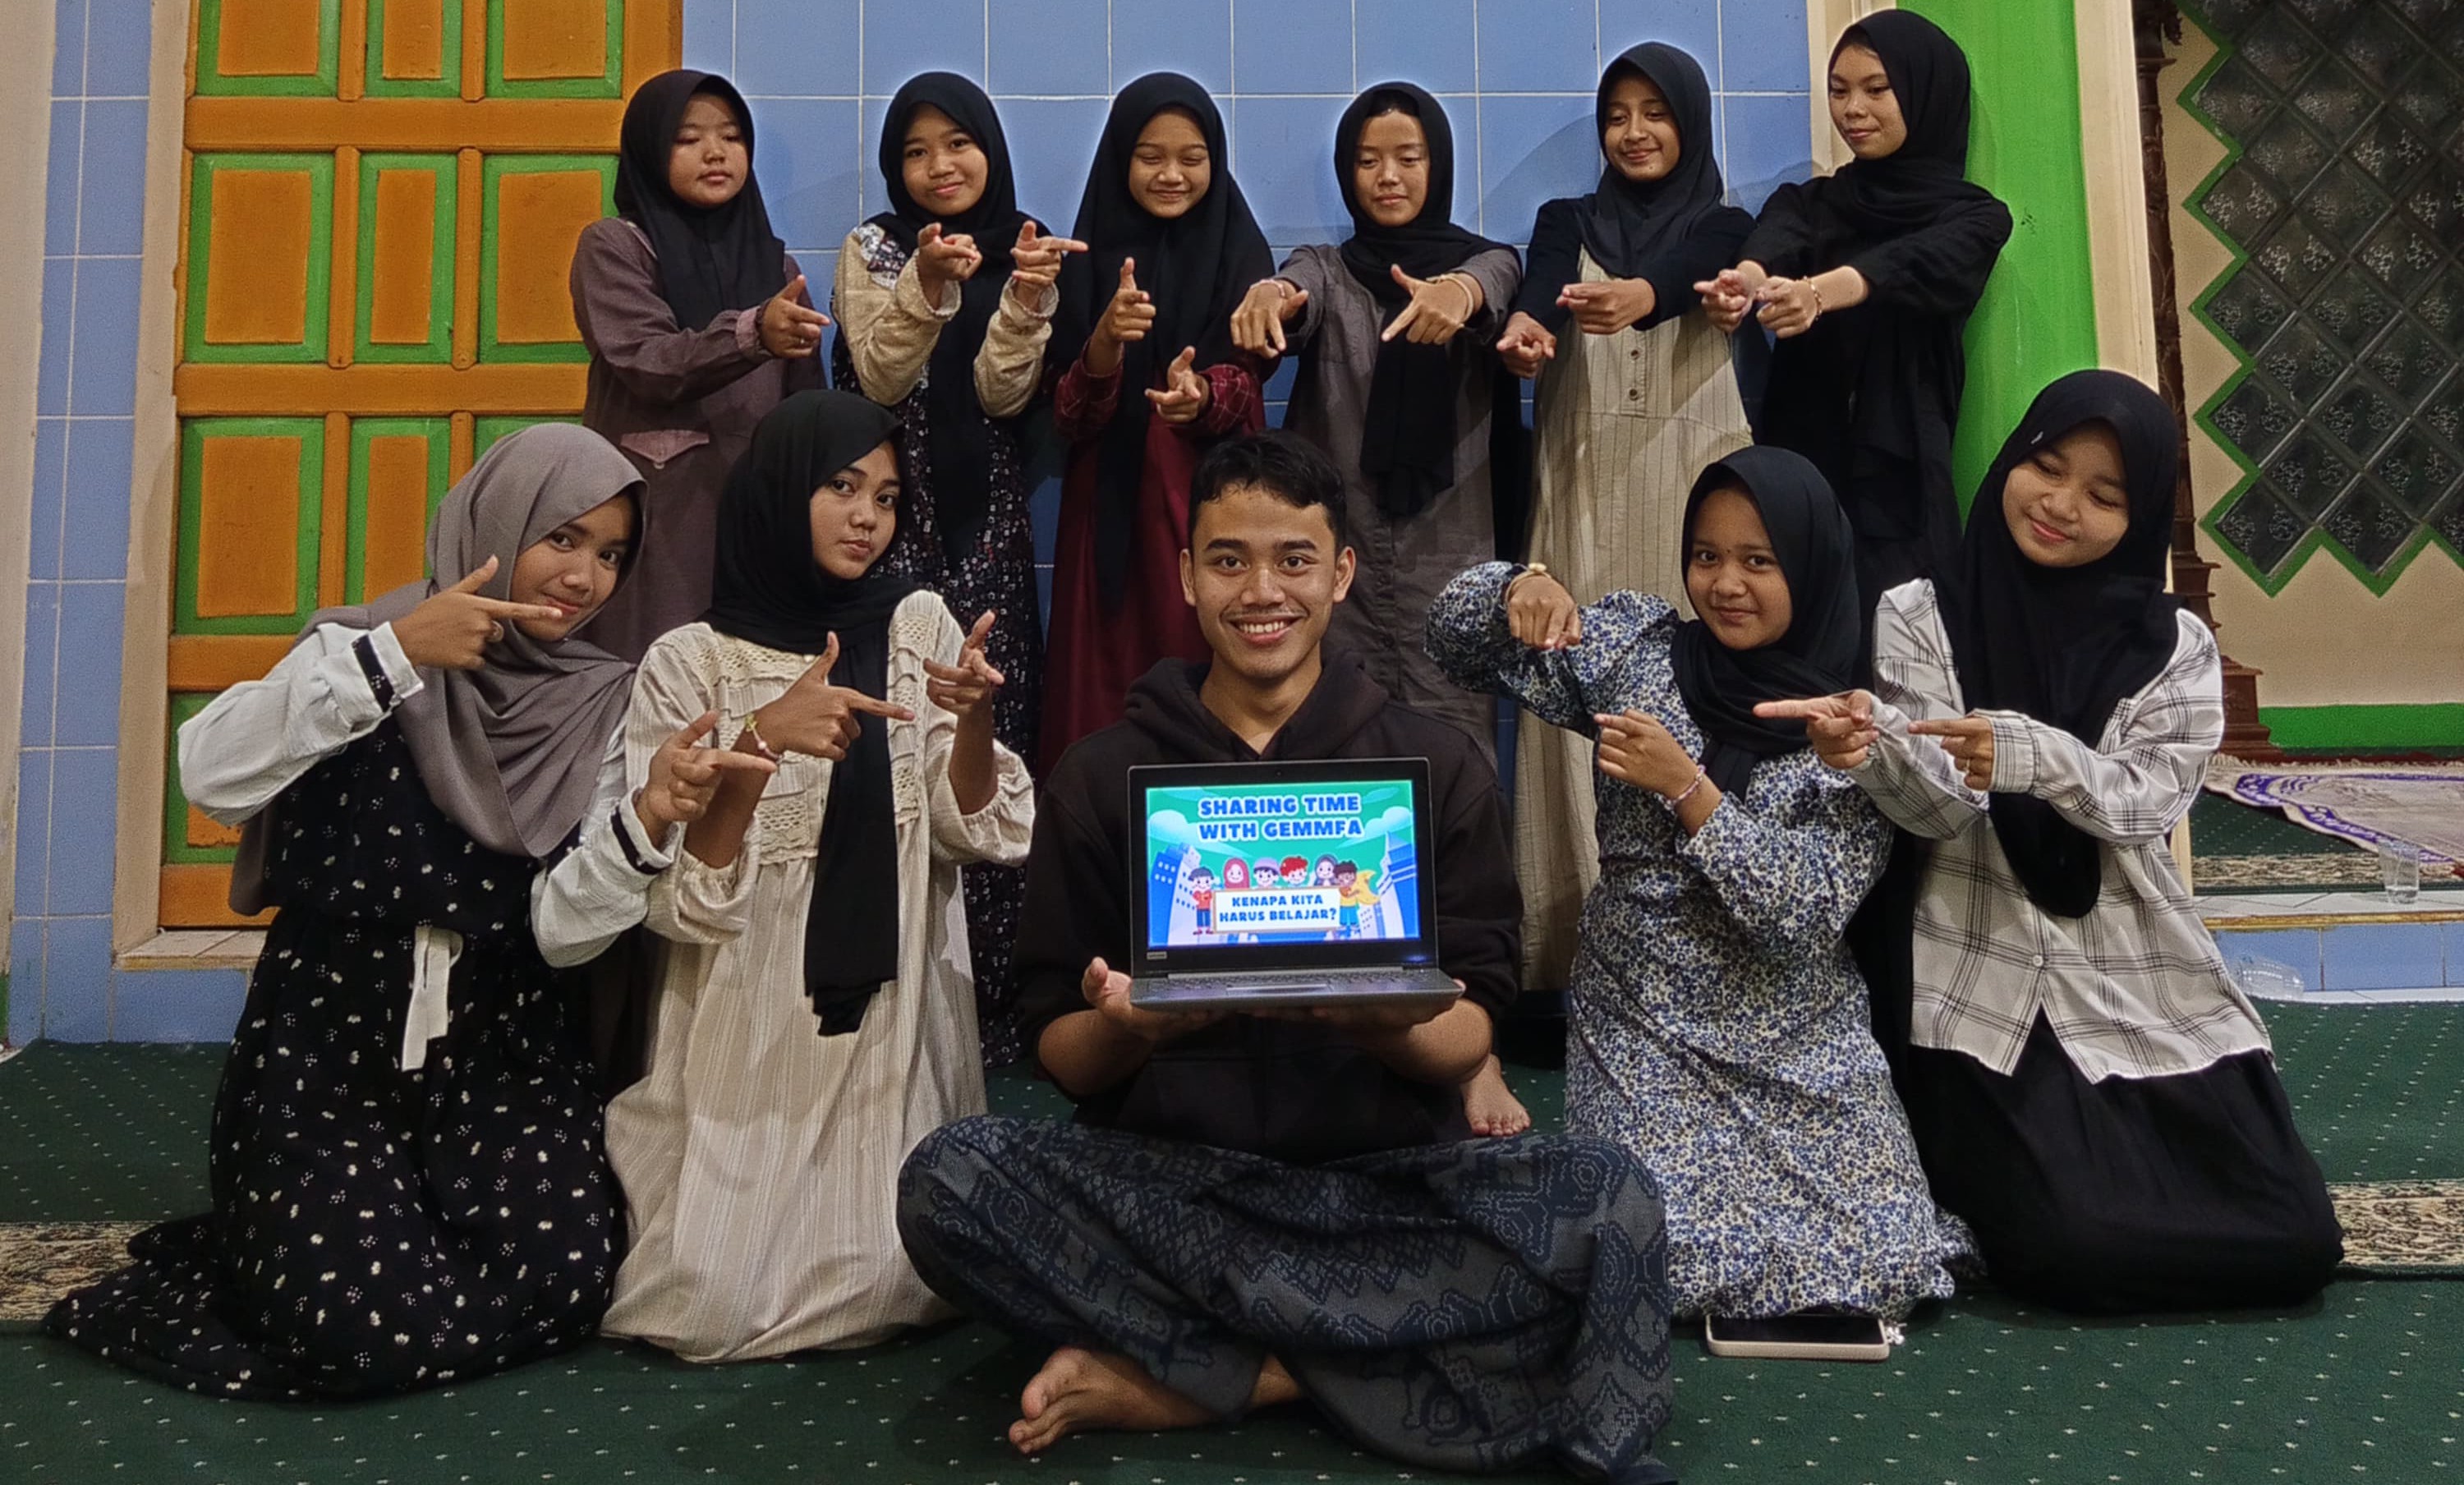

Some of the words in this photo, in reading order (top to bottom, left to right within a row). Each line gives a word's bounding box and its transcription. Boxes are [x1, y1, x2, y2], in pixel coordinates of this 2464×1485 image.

[1200, 798, 1297, 816] SHARING
[1304, 796, 1359, 811] TIME
[1199, 823, 1257, 839] WITH
[1264, 820, 1363, 838] GEMMFA
[1232, 895, 1287, 908] KENAPA
[1291, 894, 1323, 905] KITA
[1220, 910, 1266, 922] HARUS
[1269, 908, 1337, 922] BELAJAR?
